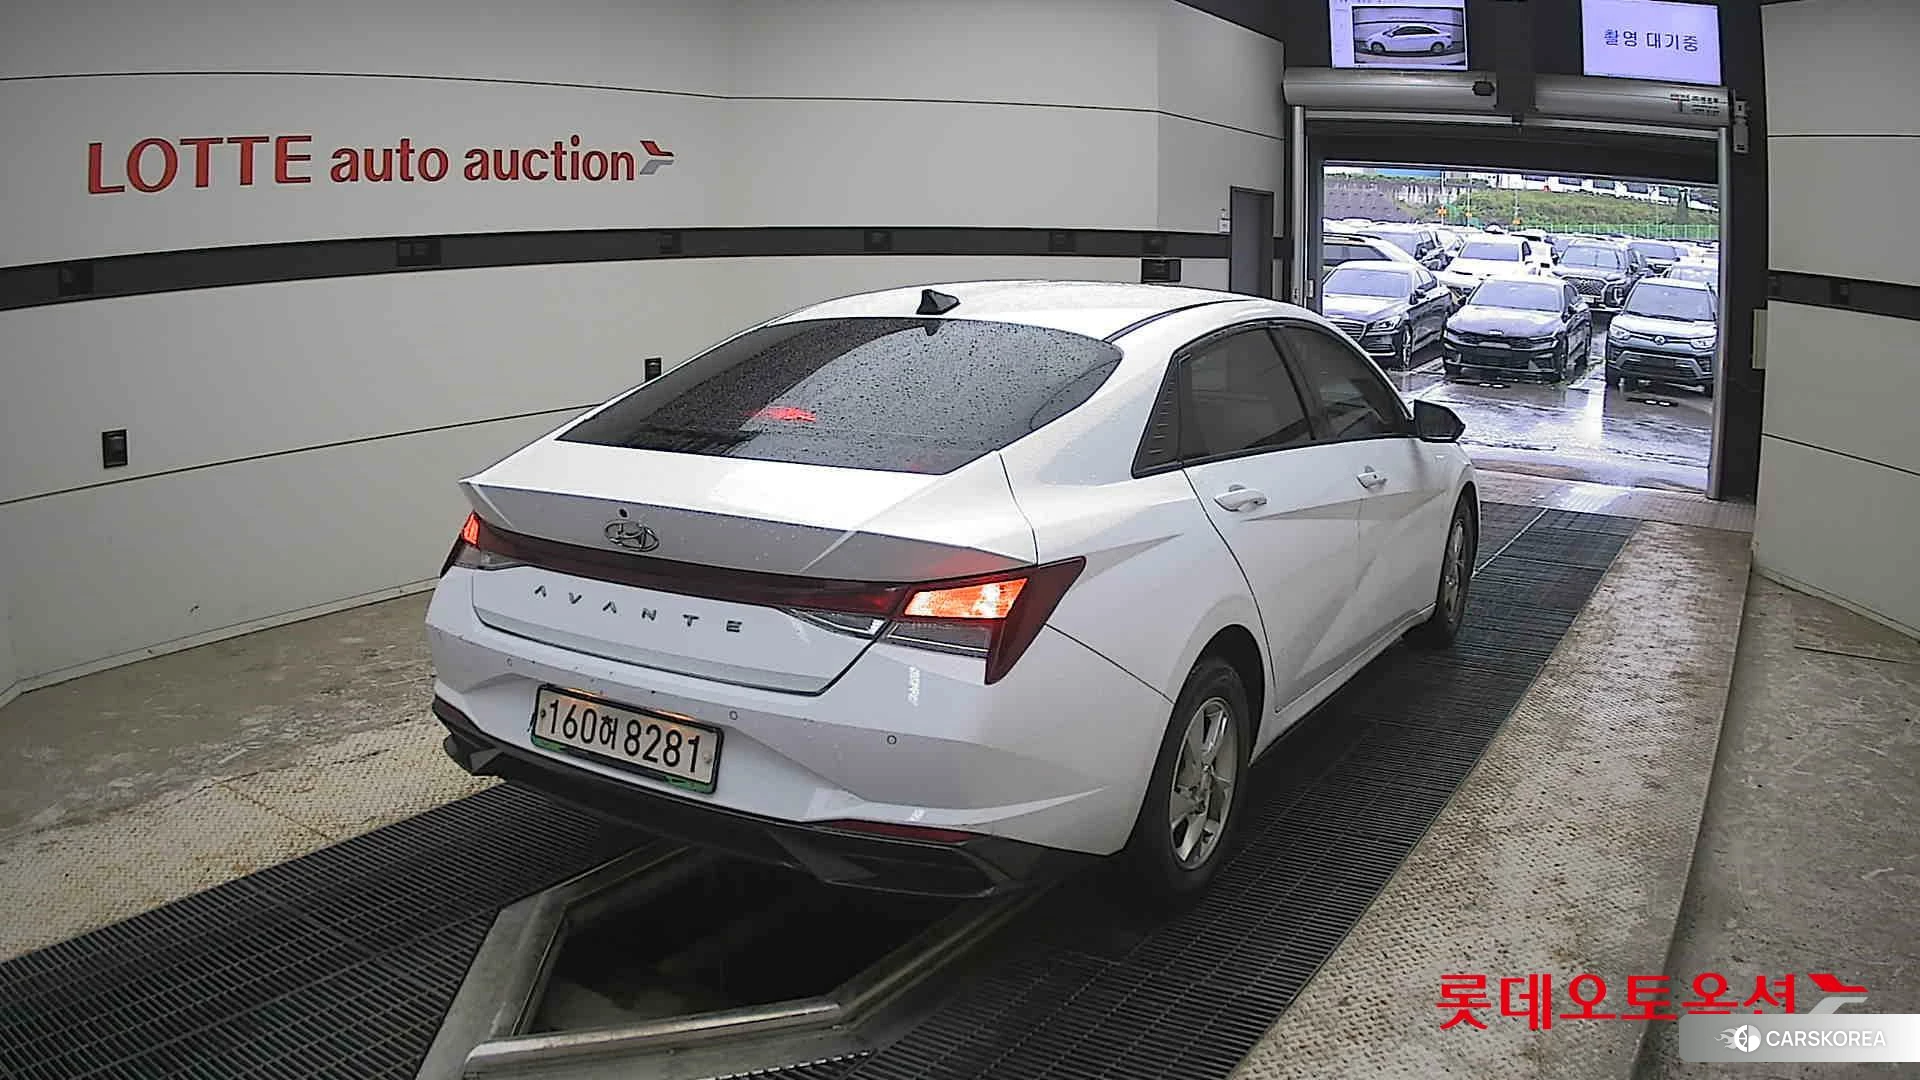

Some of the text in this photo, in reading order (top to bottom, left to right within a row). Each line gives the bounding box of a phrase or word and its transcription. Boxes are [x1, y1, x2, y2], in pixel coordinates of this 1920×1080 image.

[1604, 29, 1698, 52] 촬영 대기중
[88, 135, 636, 194] LOTTE auto auction
[534, 584, 743, 633] AVANTE
